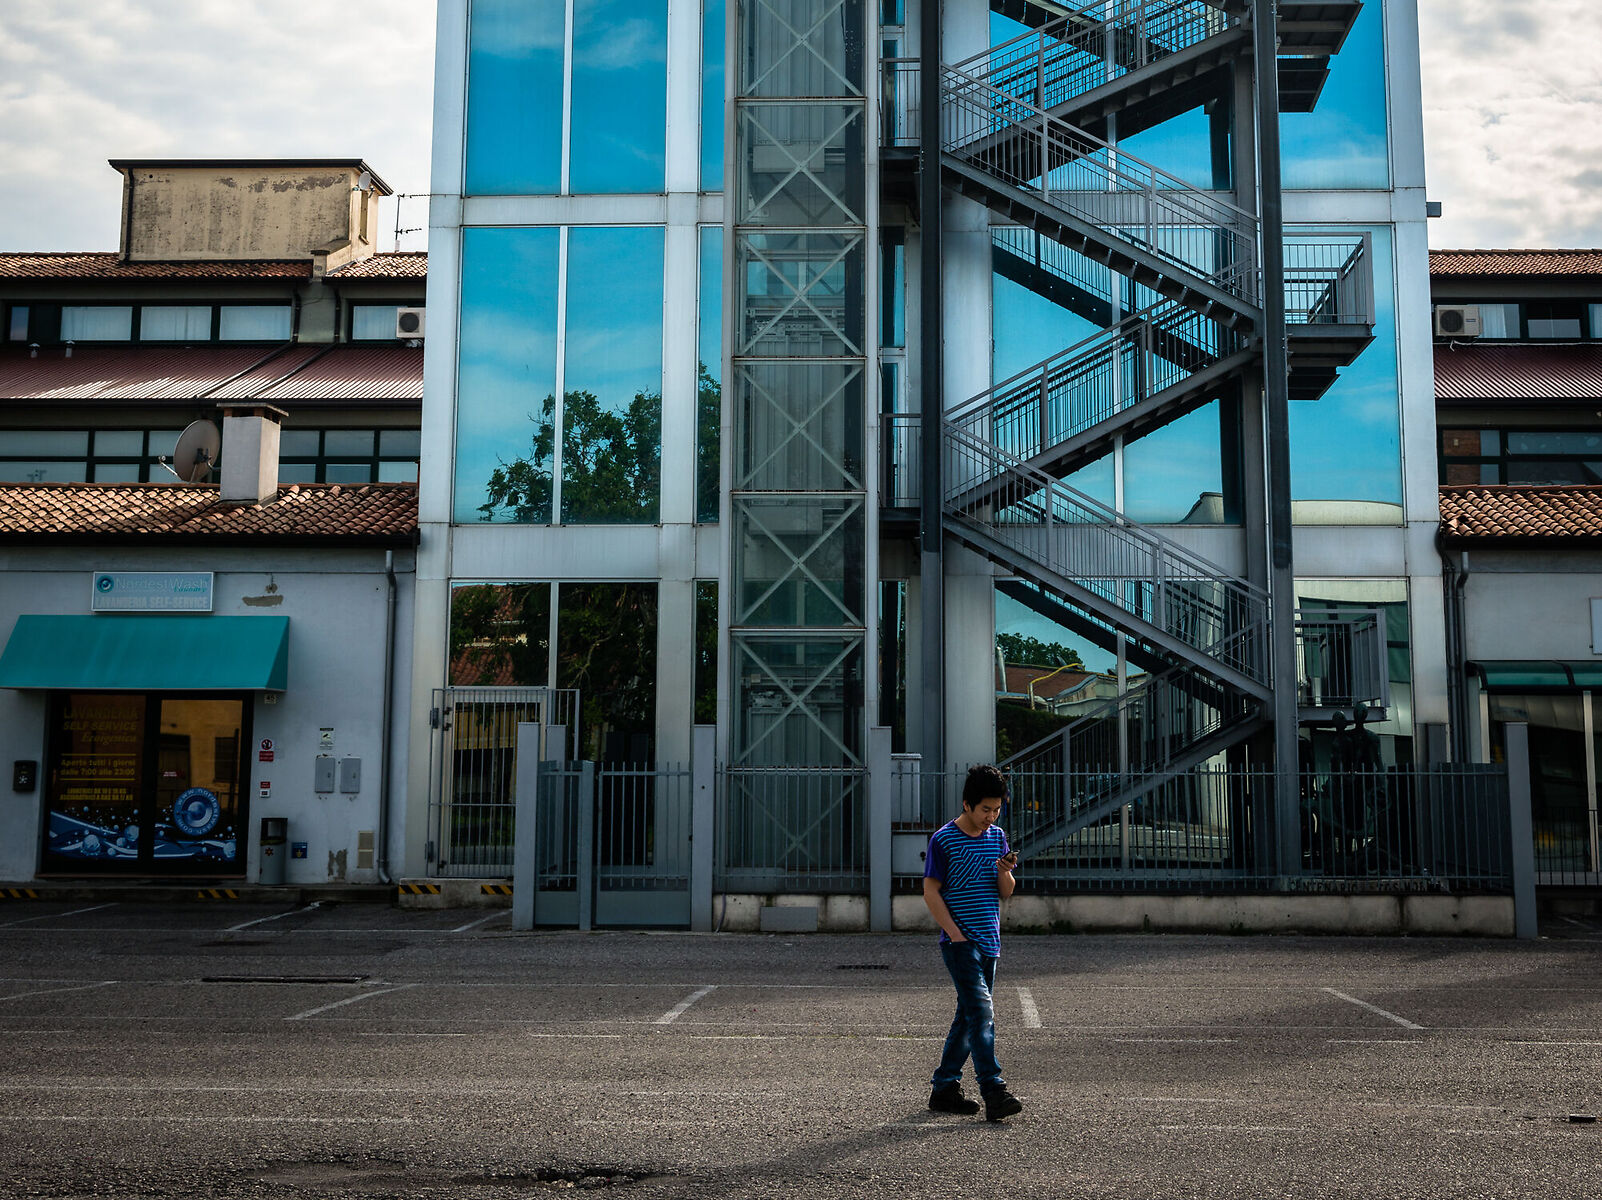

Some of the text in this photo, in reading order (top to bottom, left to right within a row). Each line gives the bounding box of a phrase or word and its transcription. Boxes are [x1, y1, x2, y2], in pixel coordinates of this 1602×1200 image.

[150, 597, 208, 609] SELF-SERVICE
[64, 721, 136, 731] SELF SERVICE
